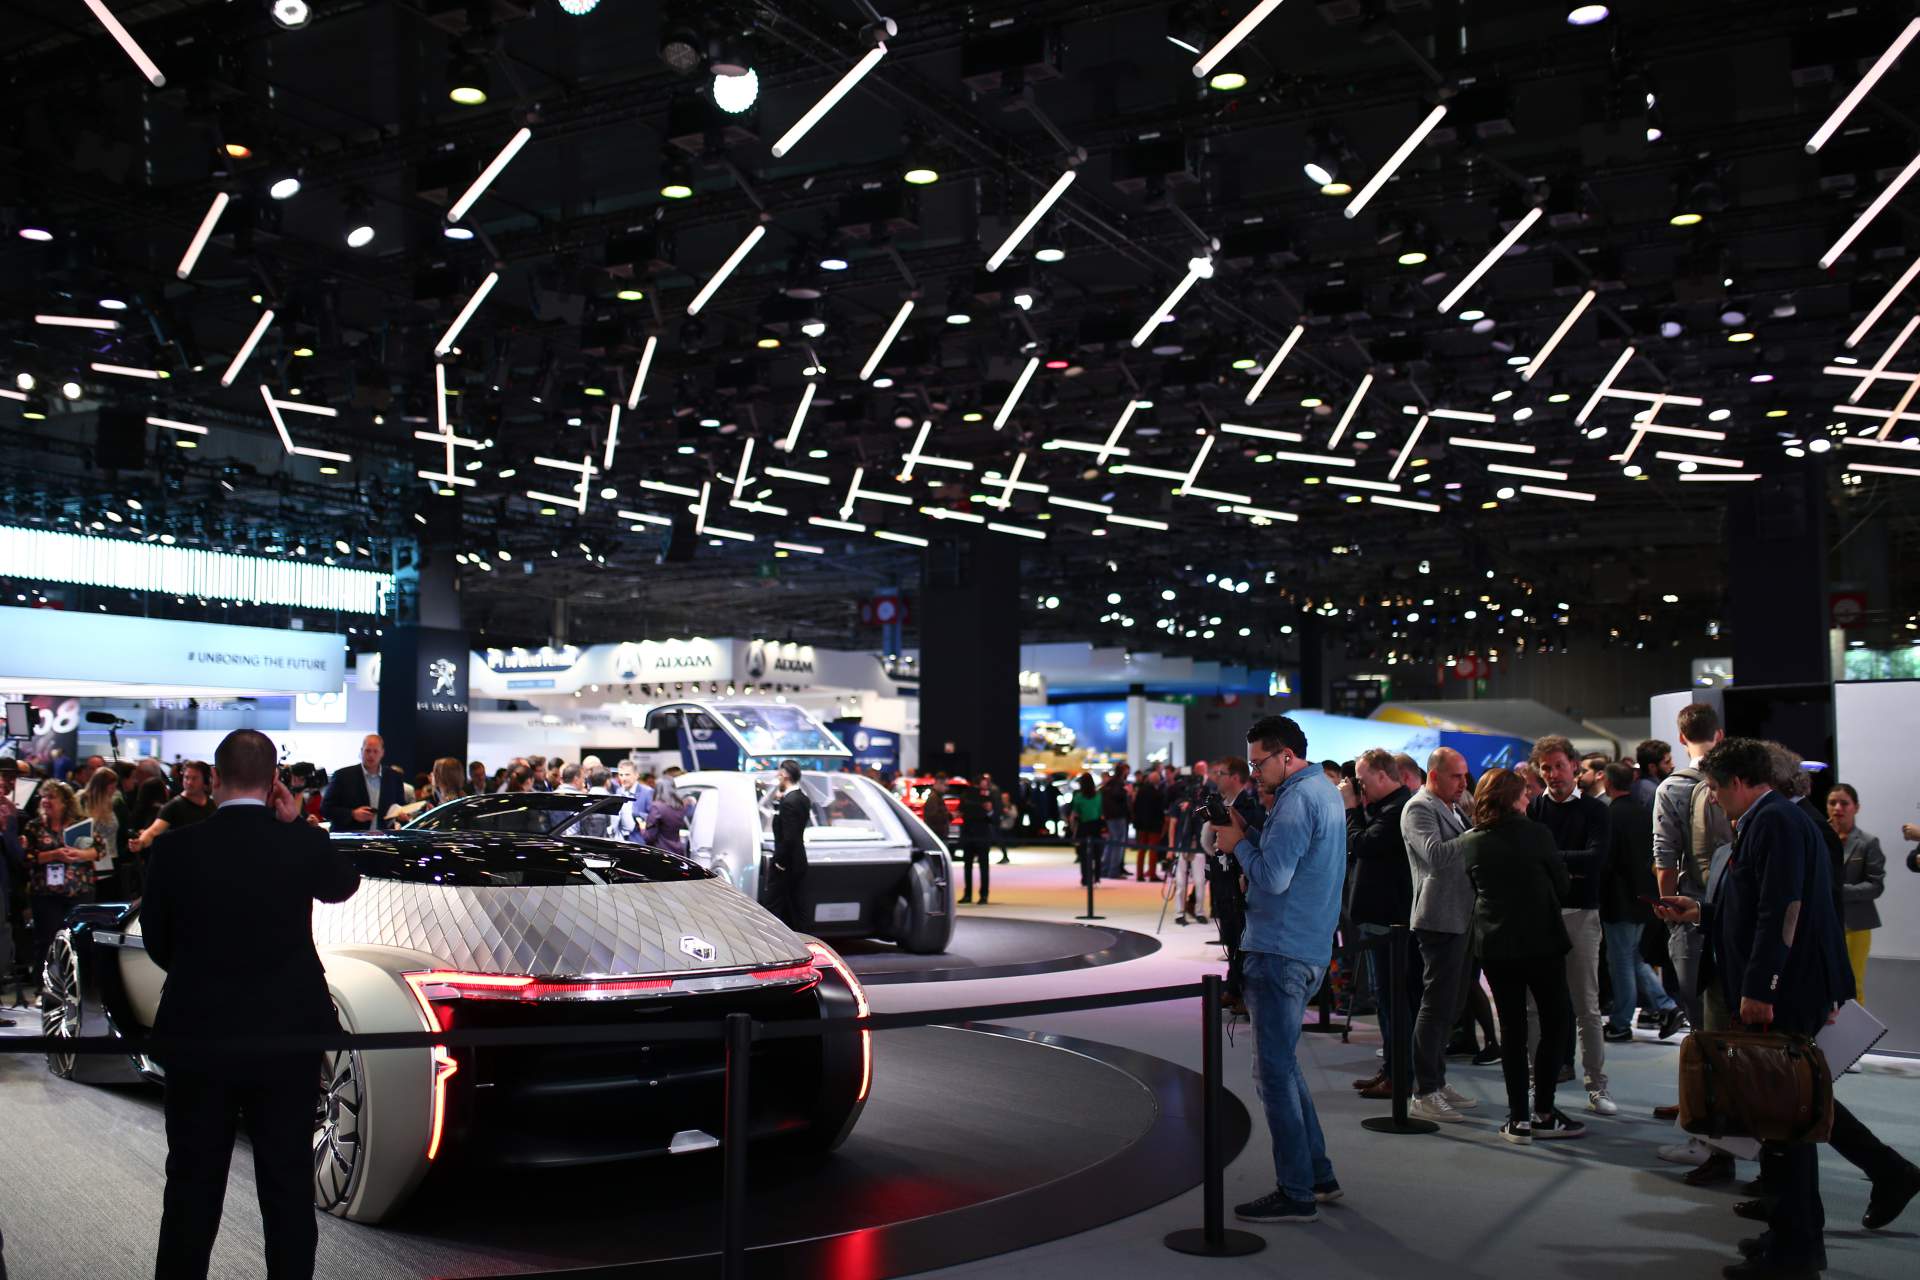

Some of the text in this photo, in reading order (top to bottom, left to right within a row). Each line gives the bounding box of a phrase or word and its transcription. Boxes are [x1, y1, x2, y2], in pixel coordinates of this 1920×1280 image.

[264, 656, 284, 669] THE
[287, 658, 327, 671] FUTURE
[656, 655, 712, 668] AIXAM
[774, 657, 814, 673] AIXAM
